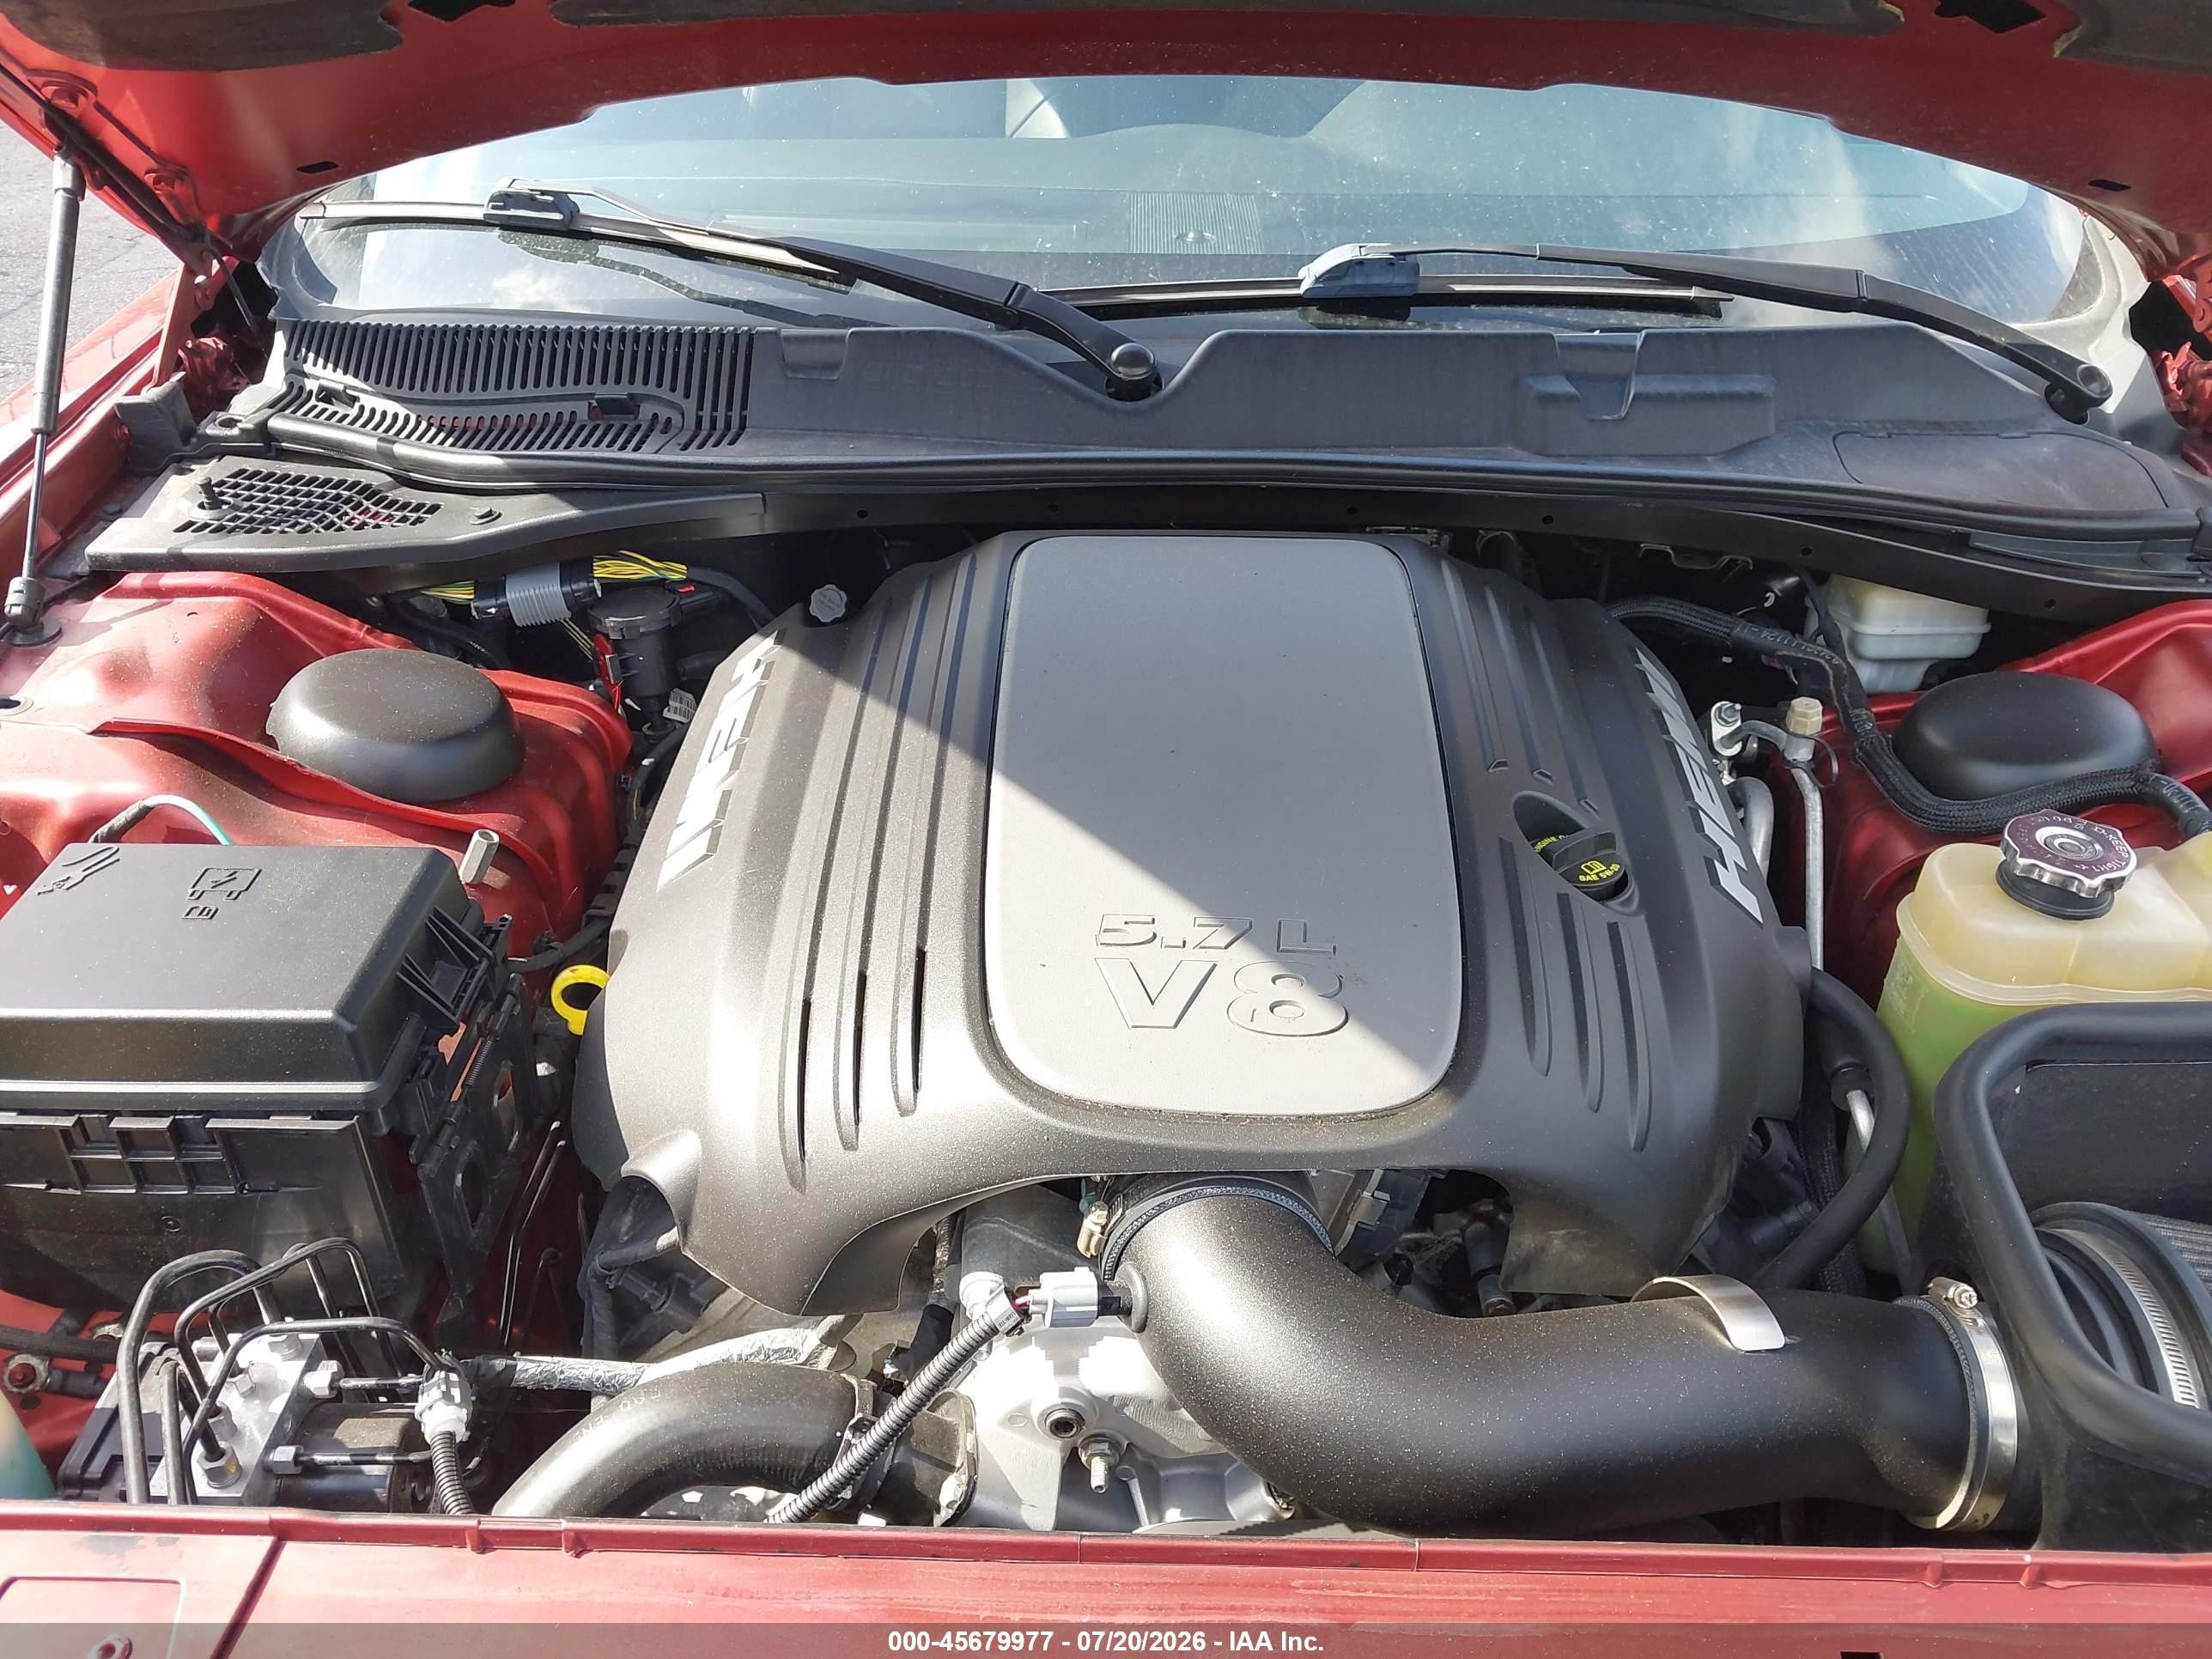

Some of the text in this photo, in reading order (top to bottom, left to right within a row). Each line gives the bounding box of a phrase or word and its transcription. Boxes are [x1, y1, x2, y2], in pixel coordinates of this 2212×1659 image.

[656, 629, 781, 894] HEMI
[1633, 647, 1764, 927] HEMI
[1578, 863, 1620, 882] SAE 5W-20
[1094, 957, 1349, 1037] V8
